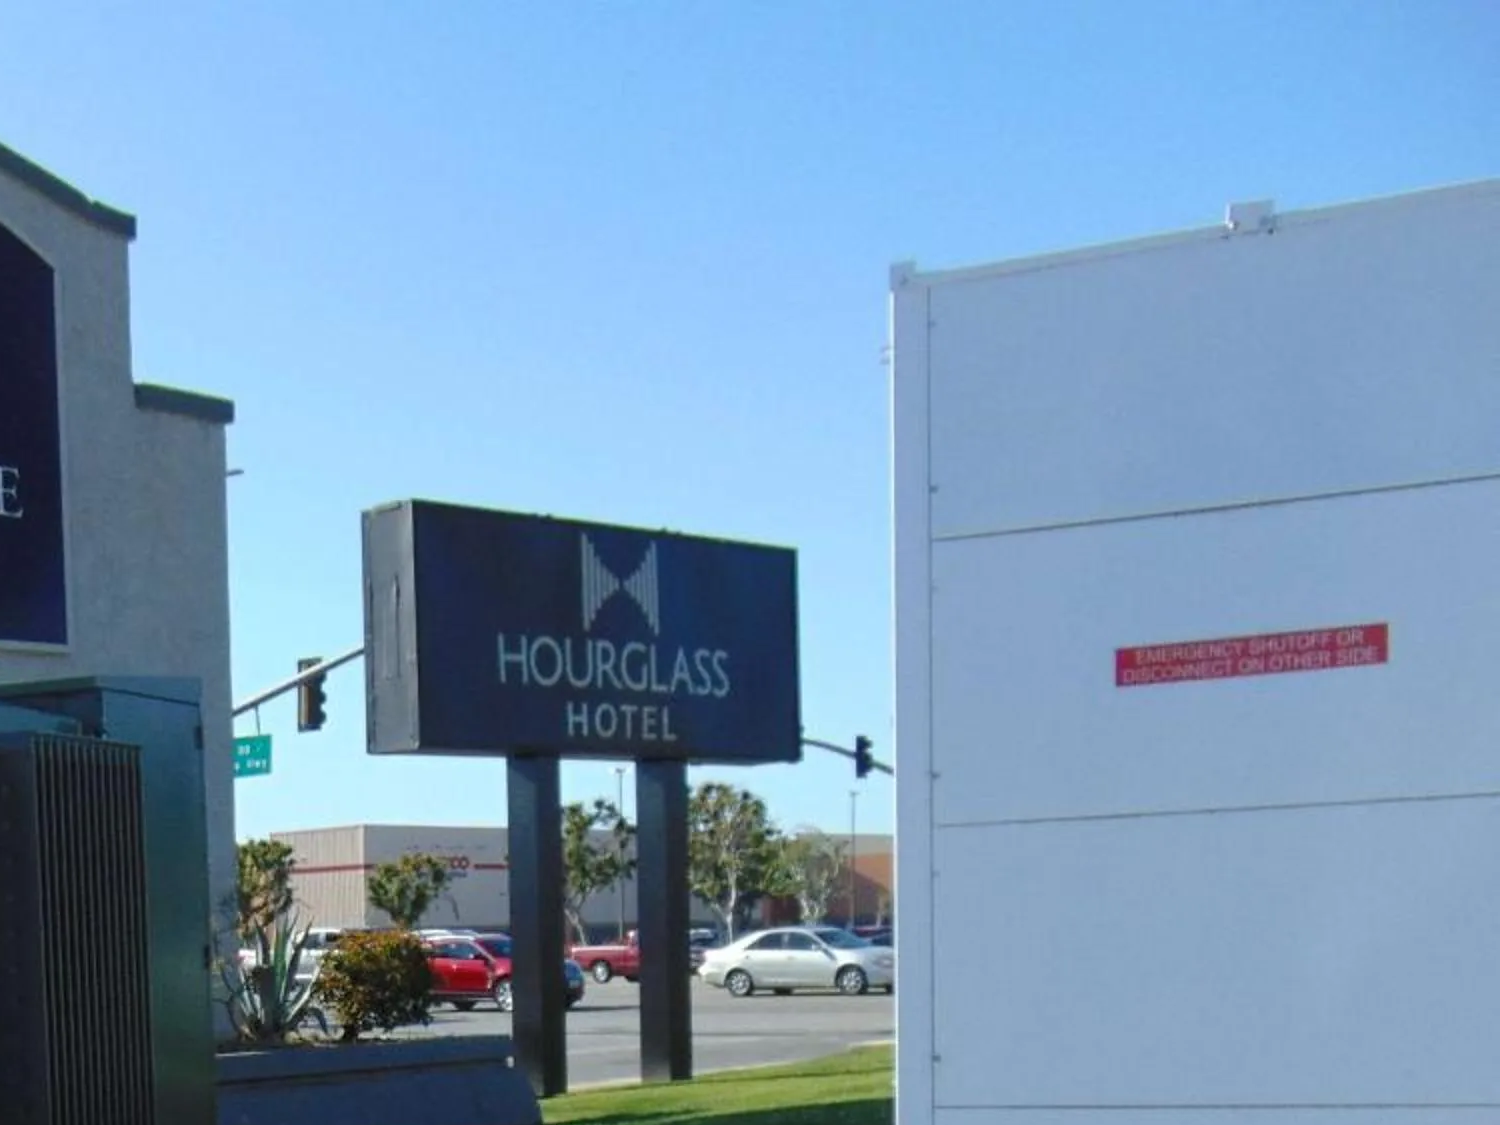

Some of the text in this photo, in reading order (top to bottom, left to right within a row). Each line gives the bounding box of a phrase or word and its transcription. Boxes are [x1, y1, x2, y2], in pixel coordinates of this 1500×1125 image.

[497, 631, 731, 698] HOURGLASS
[1121, 645, 1379, 684] DISCONNECT ON OTHER SIDE
[1135, 627, 1365, 665] EMERGENCY SHUTOFF OR
[565, 701, 678, 742] HOTEL
